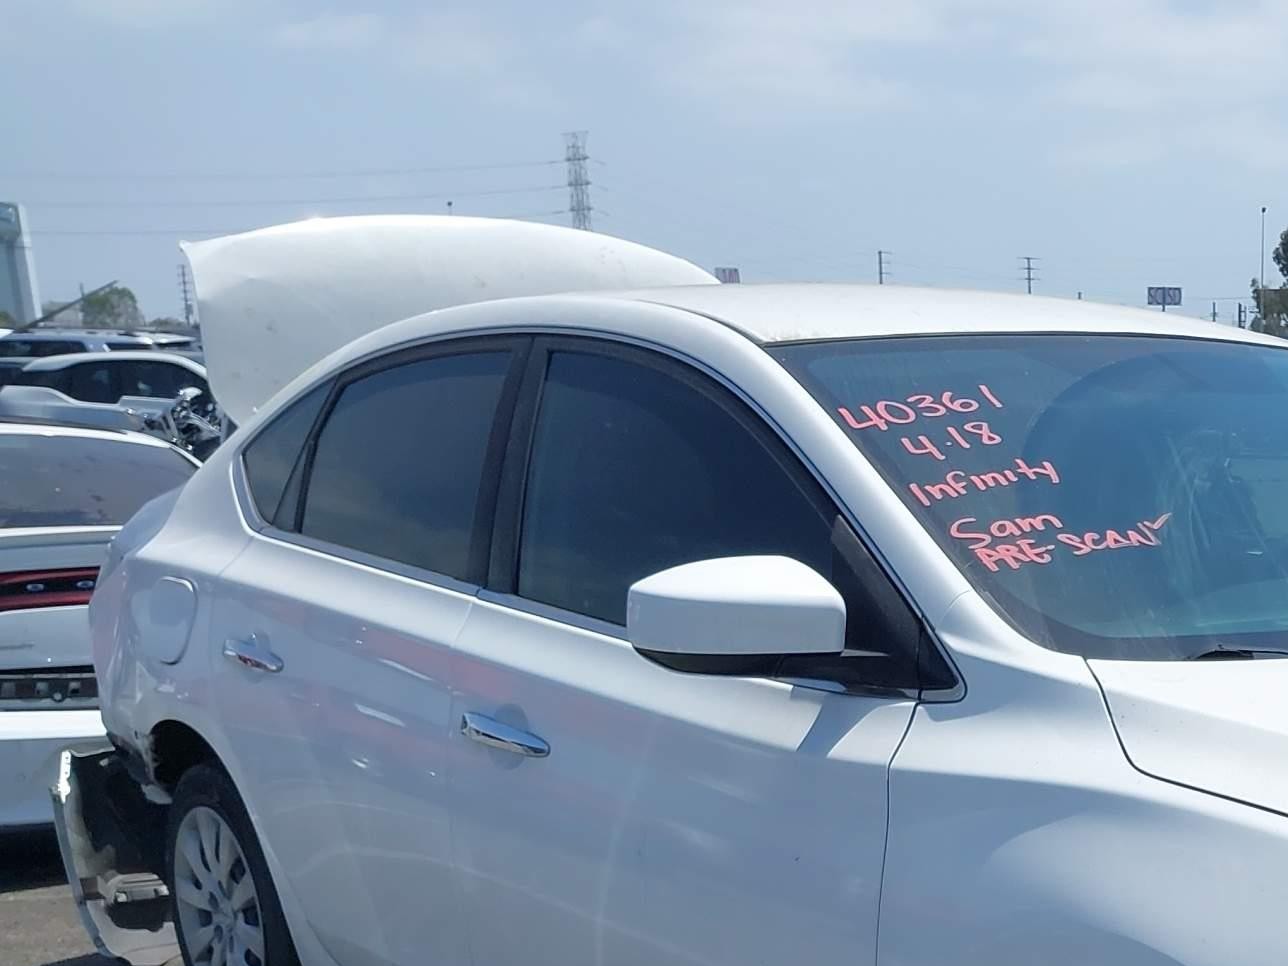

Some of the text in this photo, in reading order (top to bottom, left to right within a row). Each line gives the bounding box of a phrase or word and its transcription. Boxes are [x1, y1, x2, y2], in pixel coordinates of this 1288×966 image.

[838, 384, 1003, 430] 40361
[901, 421, 1003, 461] 4.18
[949, 513, 1063, 550] Sam
